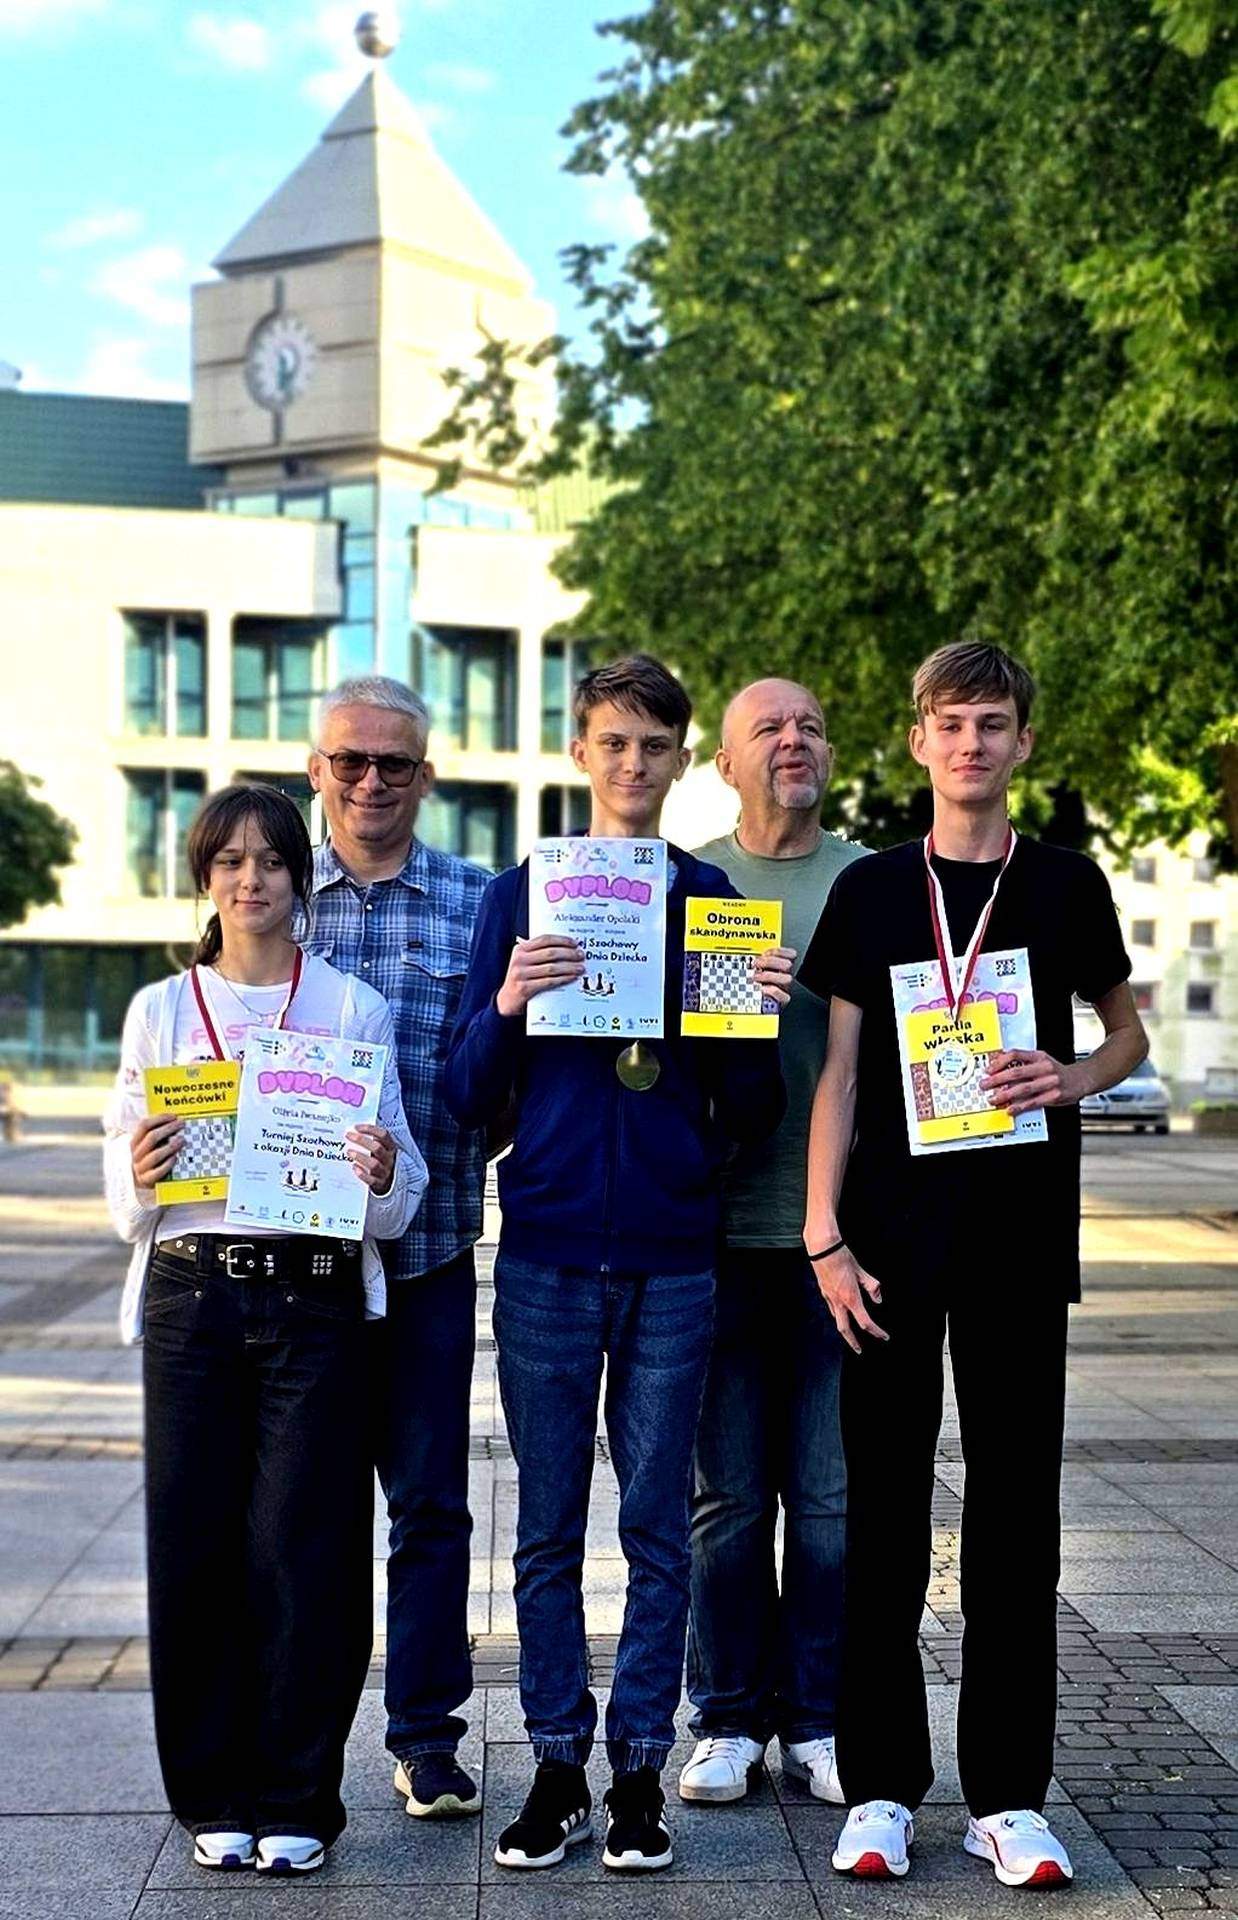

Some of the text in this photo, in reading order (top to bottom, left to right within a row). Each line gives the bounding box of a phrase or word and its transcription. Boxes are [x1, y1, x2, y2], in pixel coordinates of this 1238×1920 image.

[545, 875, 651, 905] DYPLOM
[707, 912, 760, 926] Obrona
[690, 927, 776, 940] skandynawska
[589, 937, 639, 951] Szachowy
[585, 950, 648, 963] Dnia Dziecka
[932, 1020, 972, 1035] Partia
[153, 1080, 234, 1095] Nowoczesne
[257, 1070, 366, 1108] DYPLOM
[164, 1092, 226, 1107] końcówki
[261, 1128, 295, 1144] Turniej
[296, 1134, 346, 1151] Szachowy
[260, 1143, 291, 1156] okazji
[292, 1146, 314, 1158] Dnia
